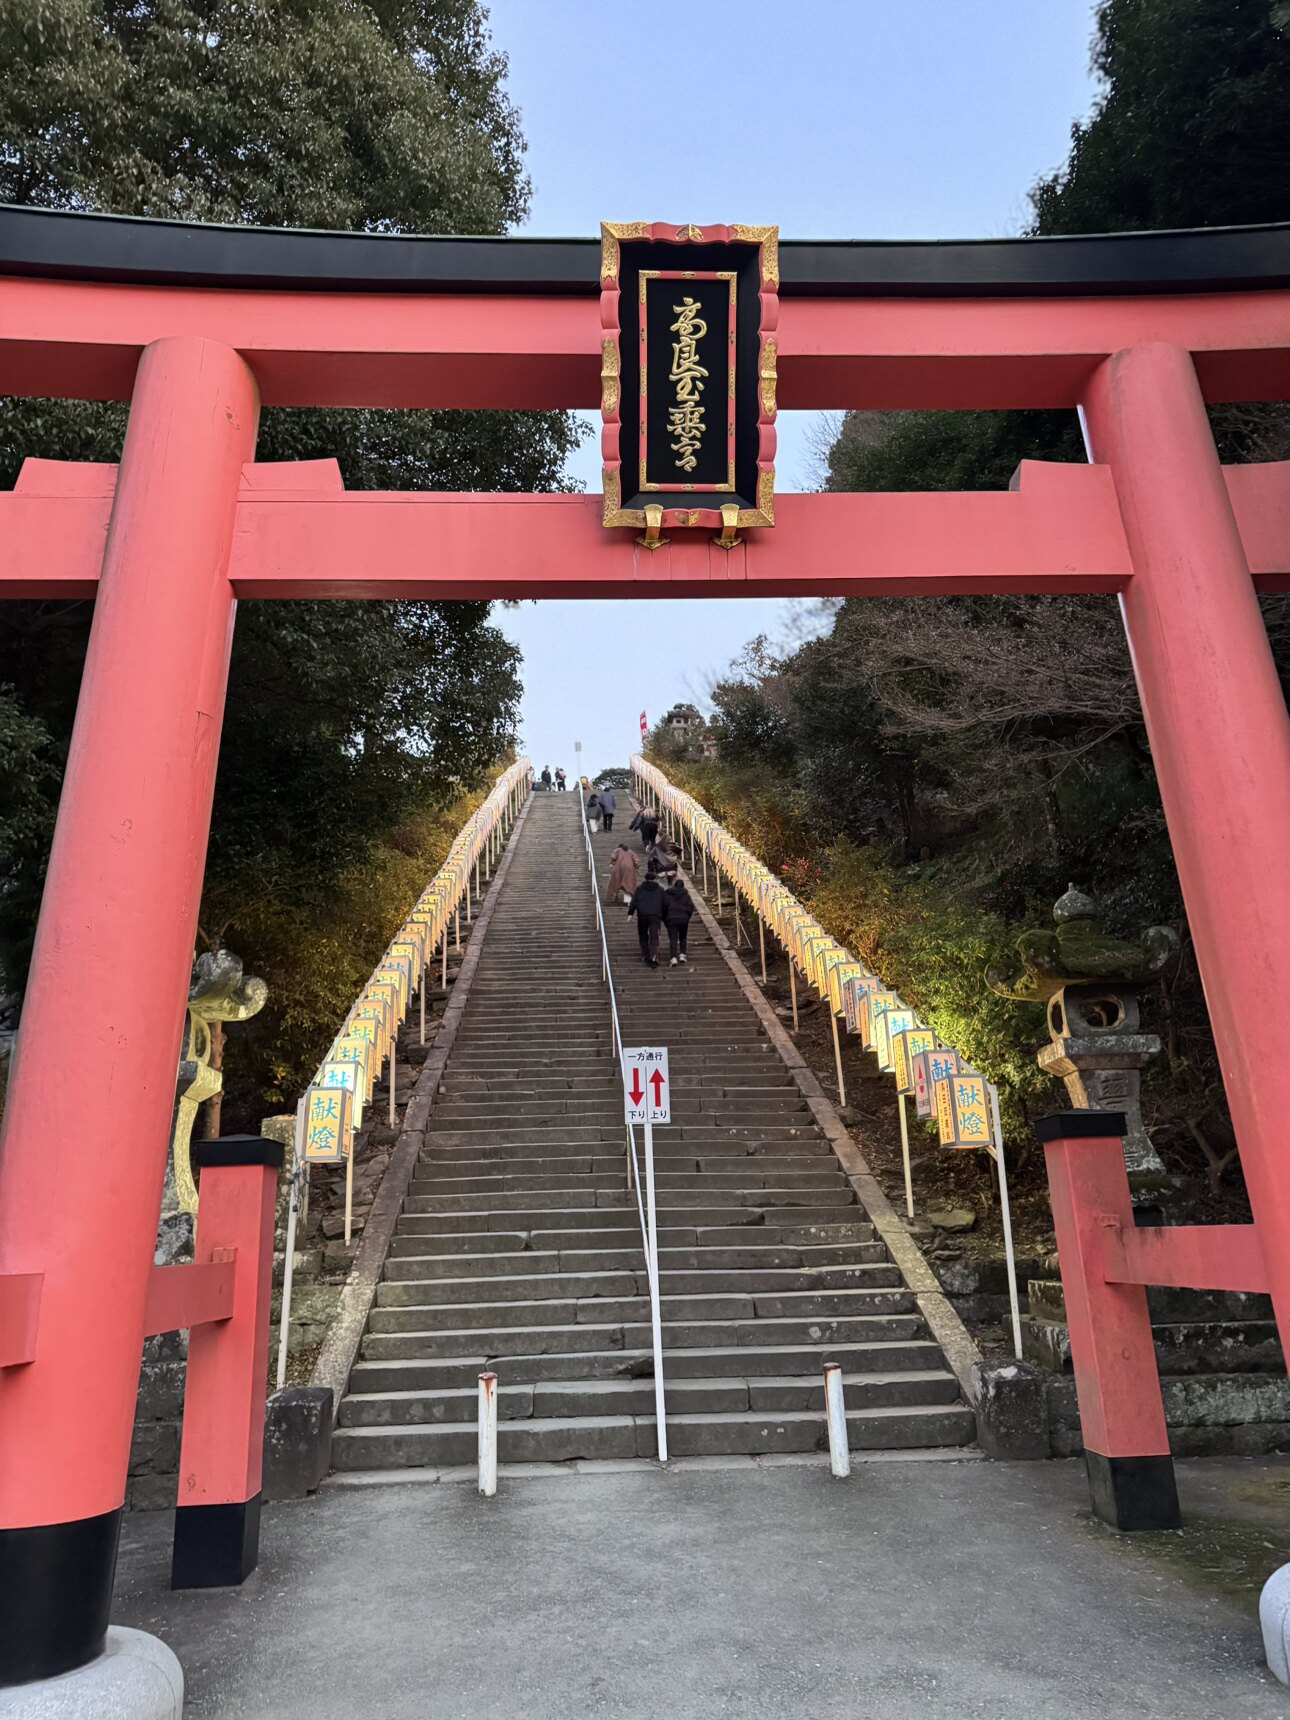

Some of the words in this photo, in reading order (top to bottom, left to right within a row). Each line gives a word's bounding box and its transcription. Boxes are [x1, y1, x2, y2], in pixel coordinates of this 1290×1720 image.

[628, 1052, 663, 1061] 一方通行
[651, 1110, 667, 1119] 上り
[957, 1084, 985, 1136] 献燈
[628, 1111, 645, 1120] 下り
[309, 1096, 338, 1151] 献燈
